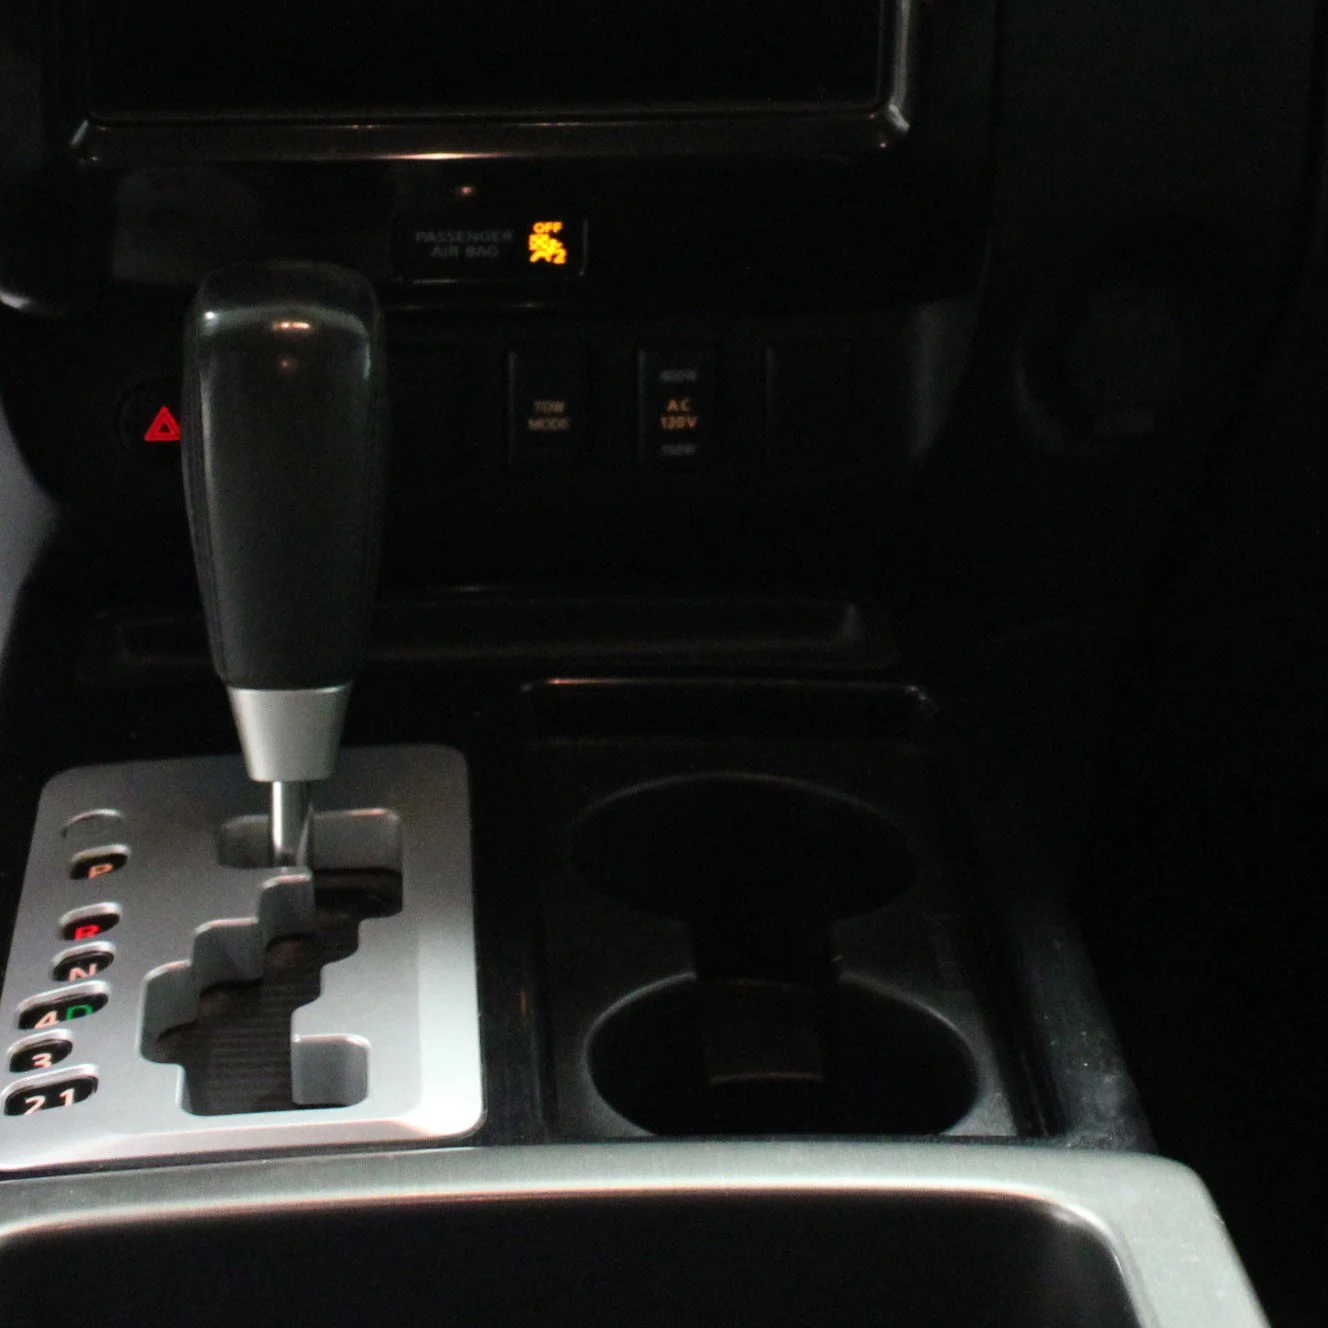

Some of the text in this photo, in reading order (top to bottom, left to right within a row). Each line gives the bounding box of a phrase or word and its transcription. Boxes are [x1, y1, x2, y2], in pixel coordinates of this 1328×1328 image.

[533, 221, 562, 233] OFF
[75, 924, 100, 940] R
[31, 1052, 52, 1069] 3
[24, 1087, 76, 1116] 2 1
